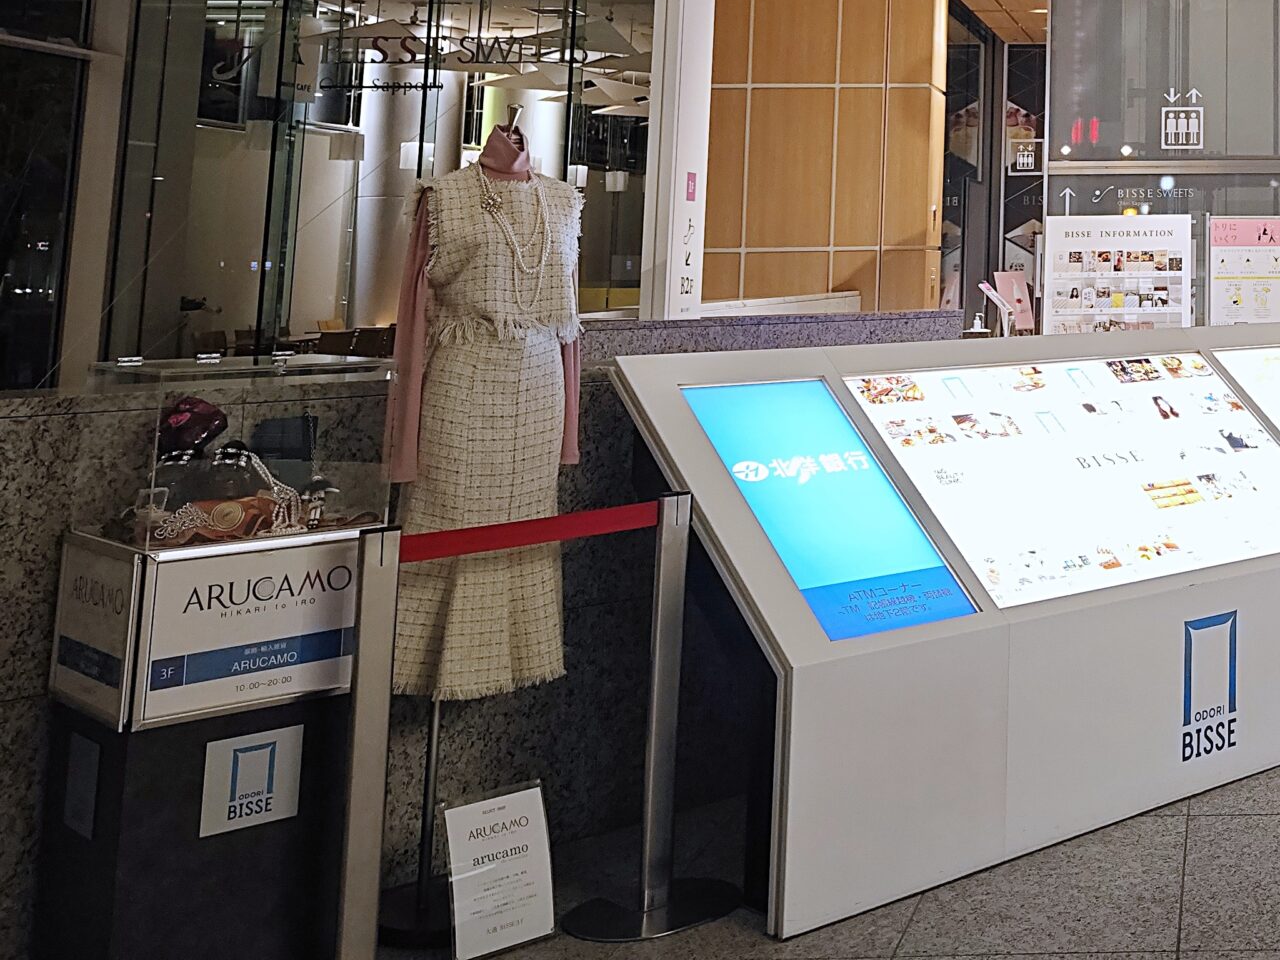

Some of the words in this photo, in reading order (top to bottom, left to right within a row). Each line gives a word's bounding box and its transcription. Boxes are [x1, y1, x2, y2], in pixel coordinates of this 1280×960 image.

[1117, 189, 1154, 198] BISSE
[1157, 188, 1194, 198] SWEETS
[1064, 230, 1092, 238] BISSE
[1100, 229, 1174, 238] INFORMATION
[1076, 450, 1144, 469] BISSE
[183, 565, 352, 614] ARUCAMO
[221, 606, 266, 618] HIKARI
[296, 598, 316, 607] IRO
[160, 667, 175, 680] 3F
[231, 651, 298, 673] ARUCAMO
[1194, 704, 1225, 722] ODORI
[1182, 718, 1237, 762] BISSE
[239, 790, 264, 800] ODORI
[227, 797, 273, 821] BISSE
[468, 816, 529, 841] ARUCAMO
[472, 843, 529, 867] arucamo
